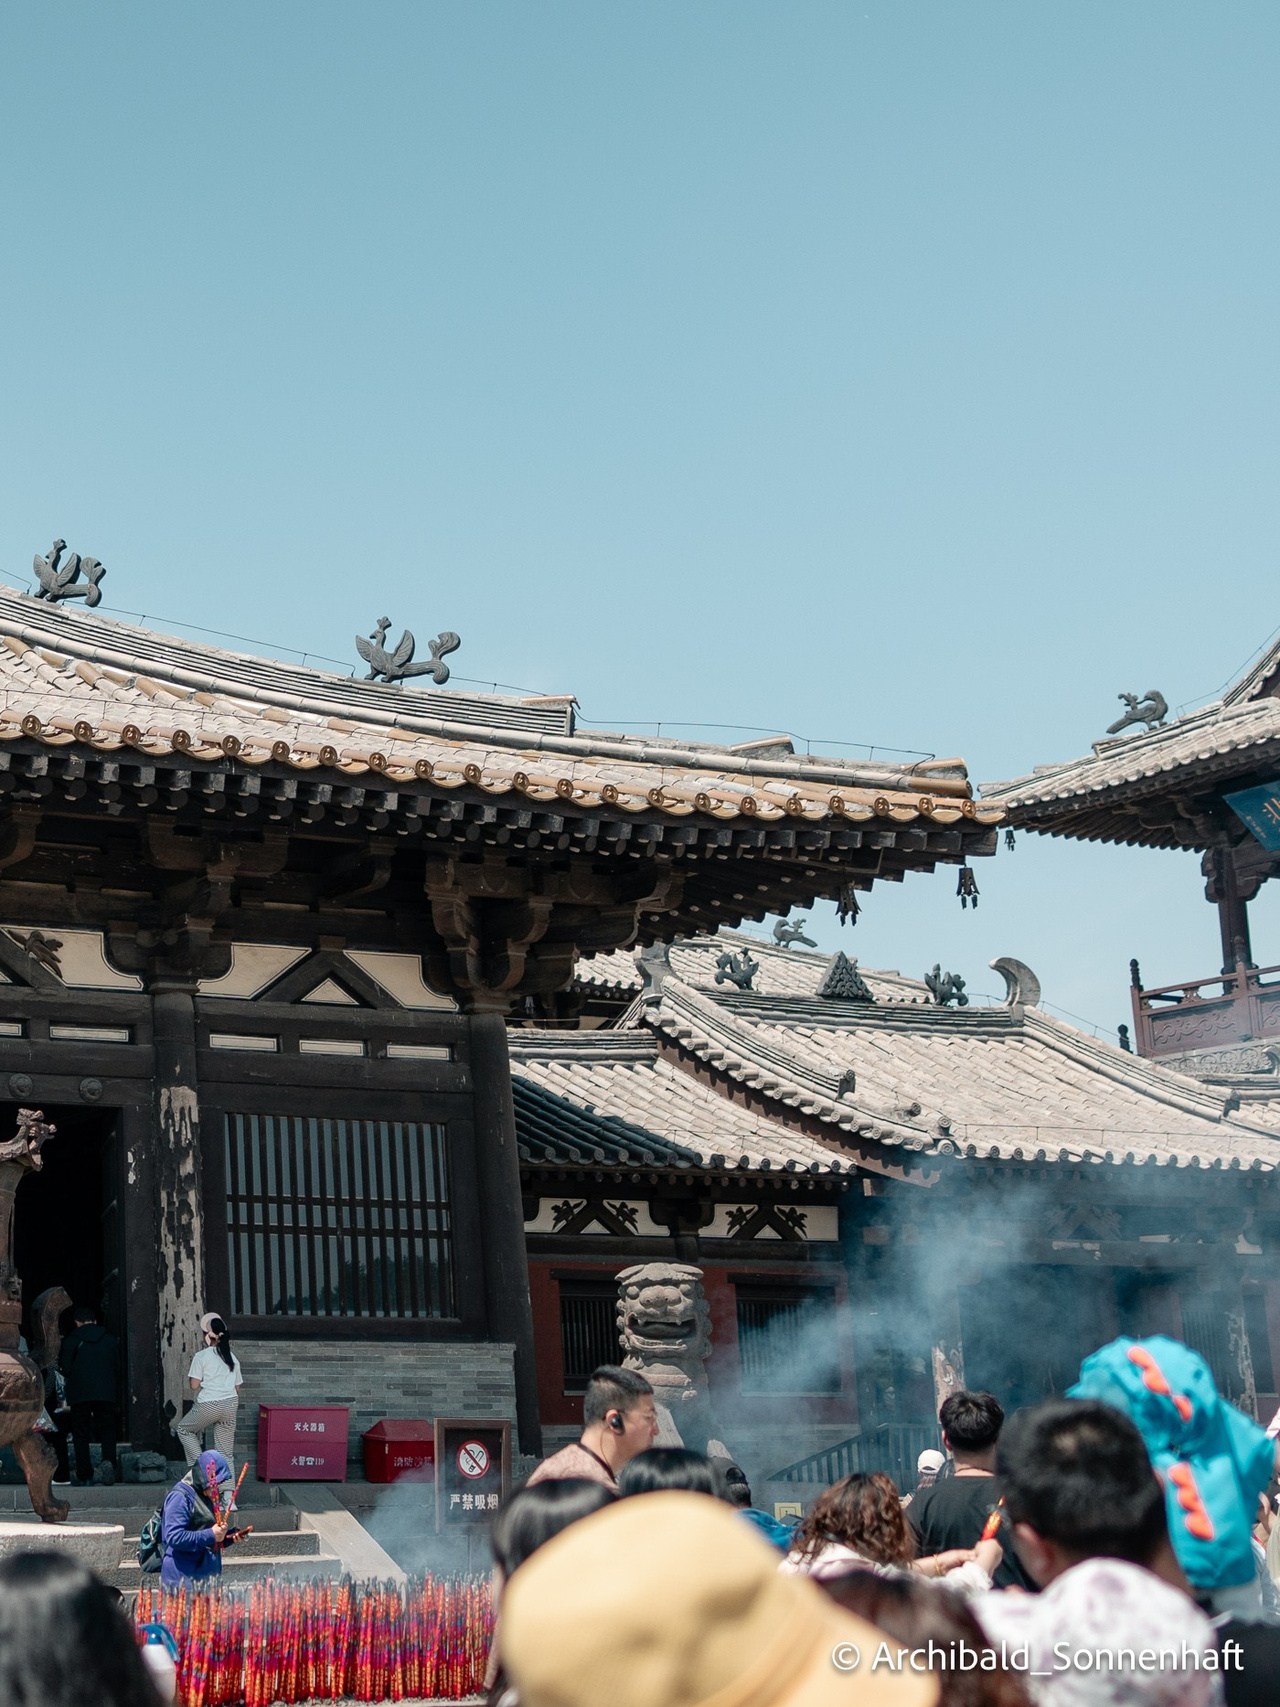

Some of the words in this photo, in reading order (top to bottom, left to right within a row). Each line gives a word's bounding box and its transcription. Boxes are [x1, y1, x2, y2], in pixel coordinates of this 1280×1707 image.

[294, 1422, 325, 1432] 灭火器箱
[450, 1493, 498, 1510] 严禁吸烟
